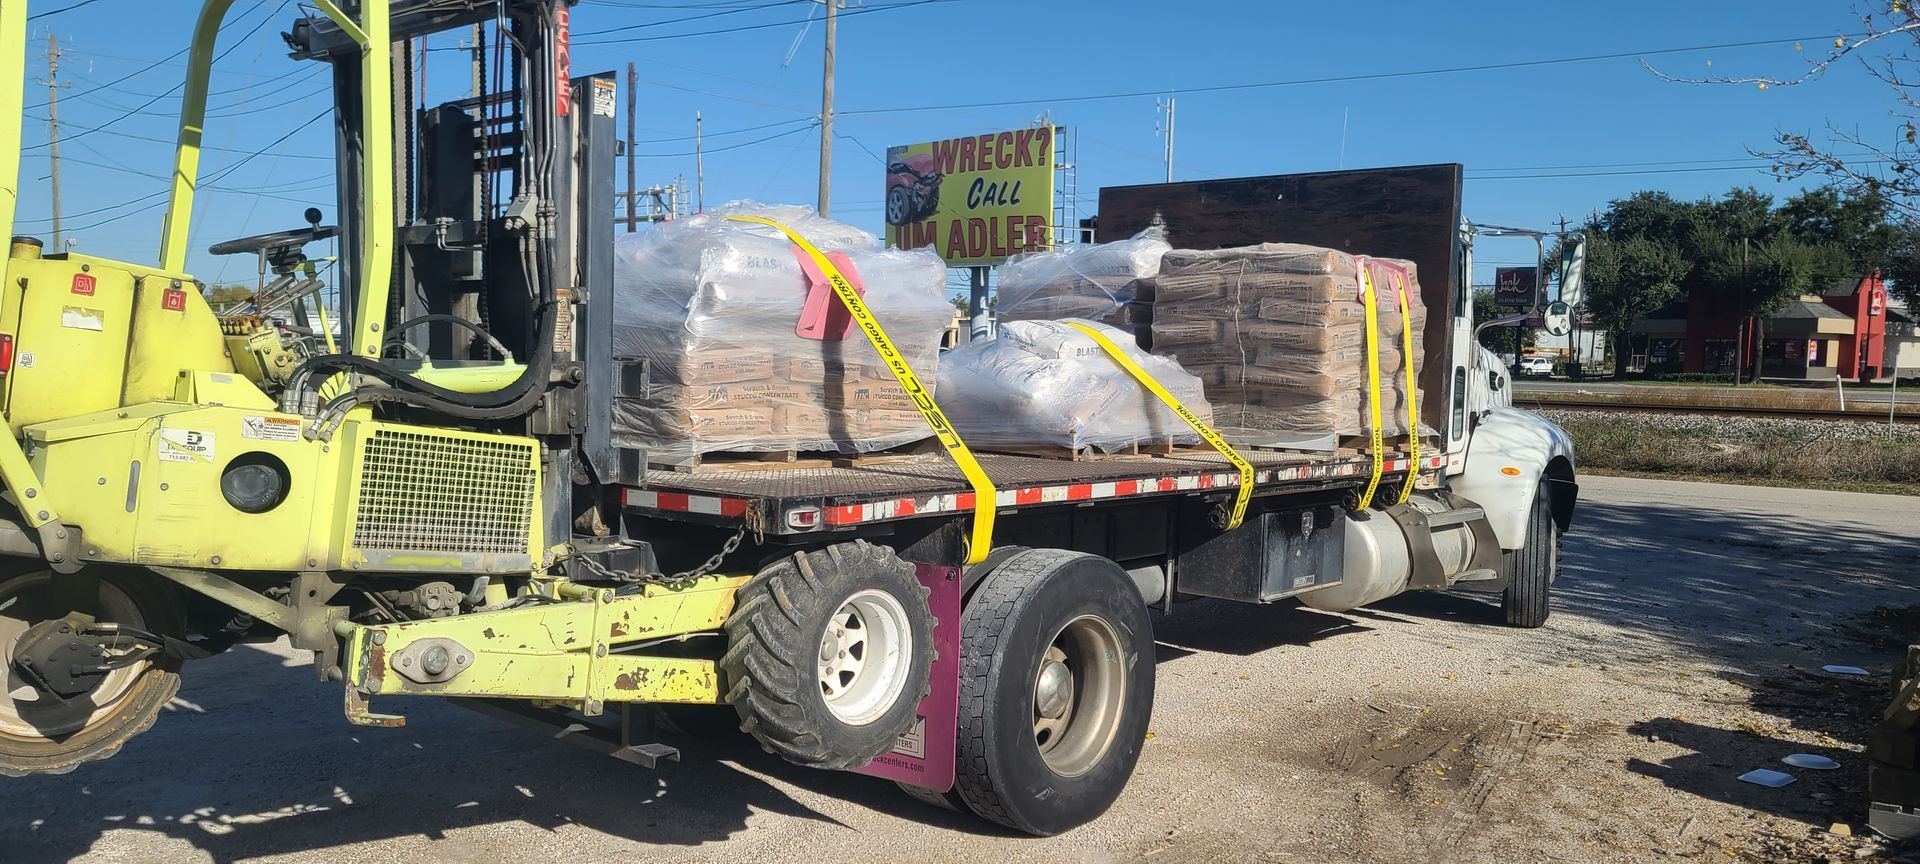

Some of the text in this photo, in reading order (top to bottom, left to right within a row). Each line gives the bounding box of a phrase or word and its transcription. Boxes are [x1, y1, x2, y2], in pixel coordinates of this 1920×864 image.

[931, 127, 1050, 175] WRECK?
[966, 177, 1021, 210] CALL
[946, 215, 1047, 259] ADLER
[831, 274, 867, 320] CONTROL
[865, 322, 894, 357] CARGO
[891, 360, 906, 375] US
[757, 392, 800, 400] CONCENTRATE
[1176, 404, 1215, 440] CONTROL
[1215, 440, 1246, 467] CARGO
[1362, 476, 1378, 508] CARGO
[1402, 469, 1417, 500] CARGO
